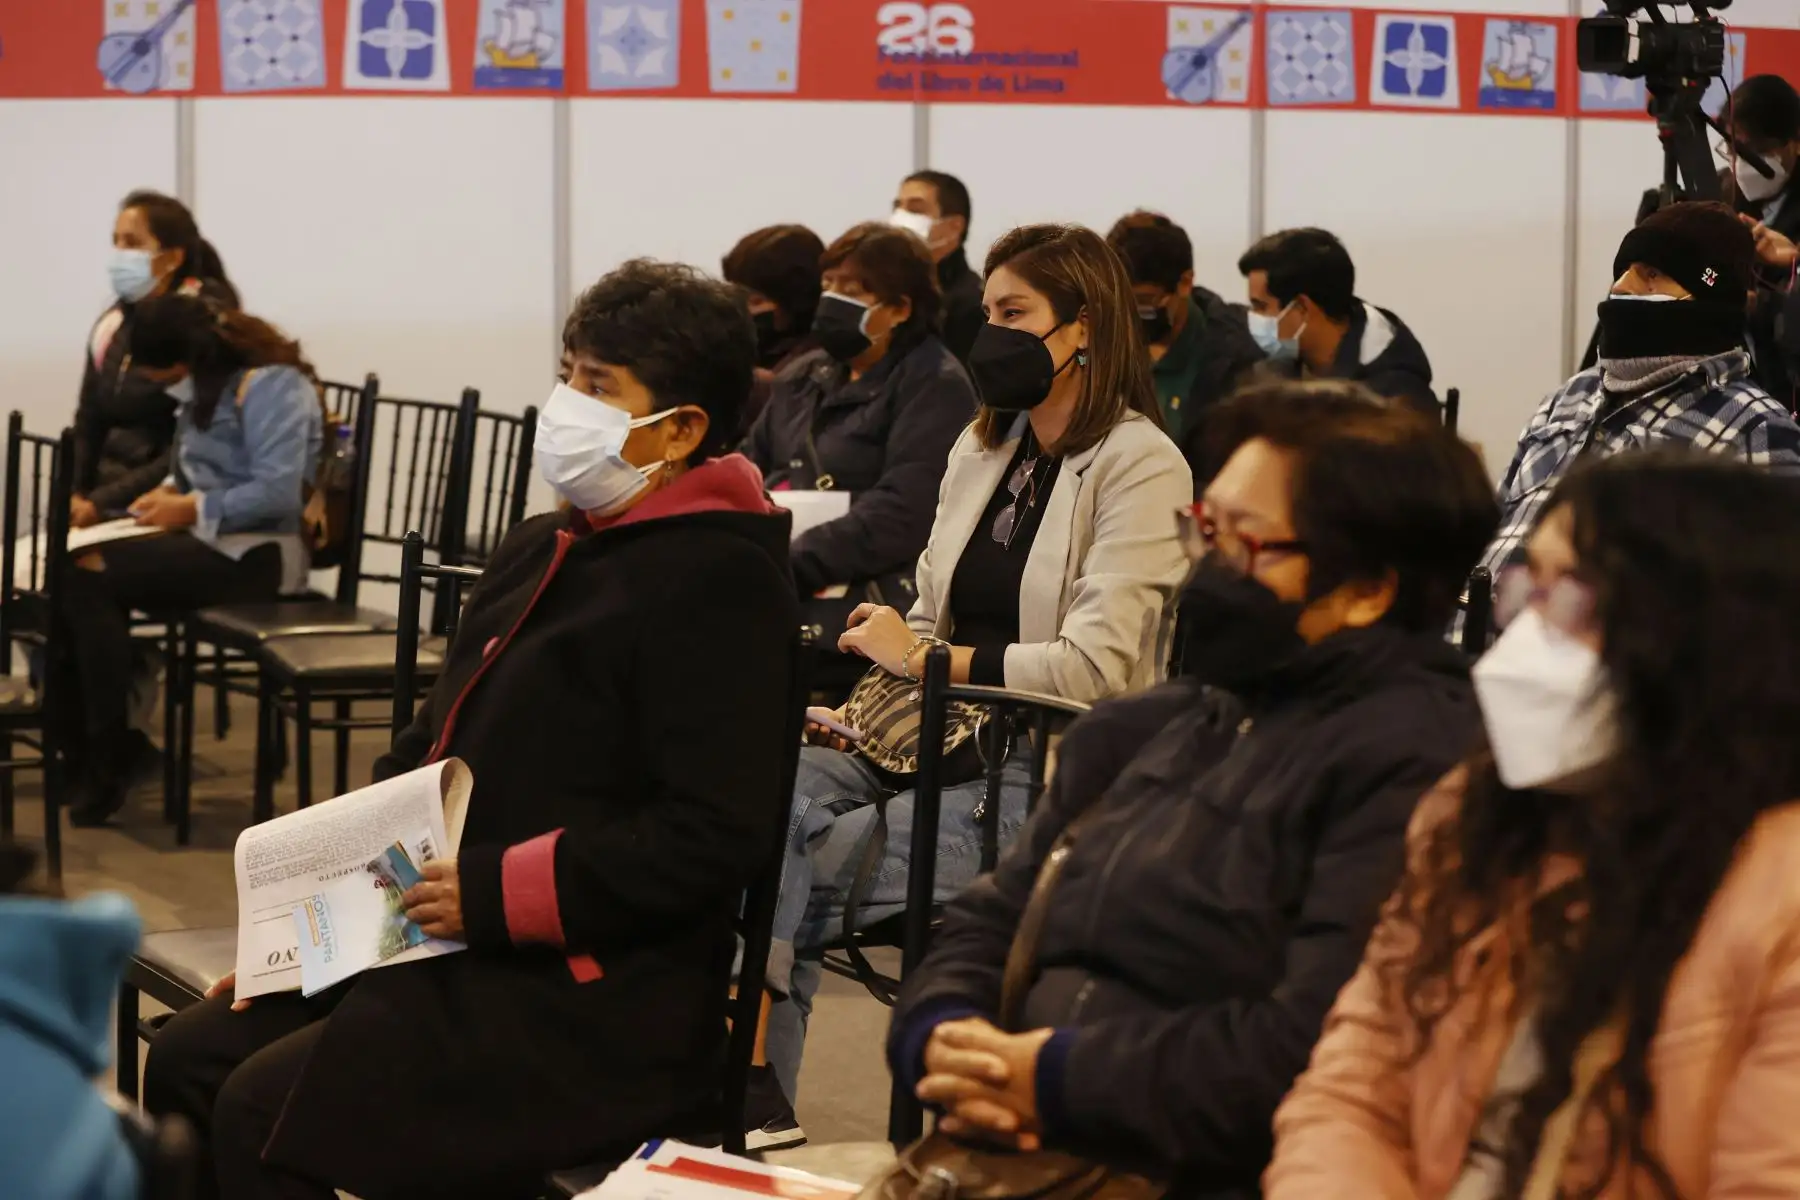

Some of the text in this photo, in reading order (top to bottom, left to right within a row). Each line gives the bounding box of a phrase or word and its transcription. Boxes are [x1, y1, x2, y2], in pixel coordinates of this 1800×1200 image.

[876, 2, 975, 56] 26
[877, 71, 914, 91] del
[978, 74, 1006, 92] de
[1013, 74, 1066, 93] Lima
